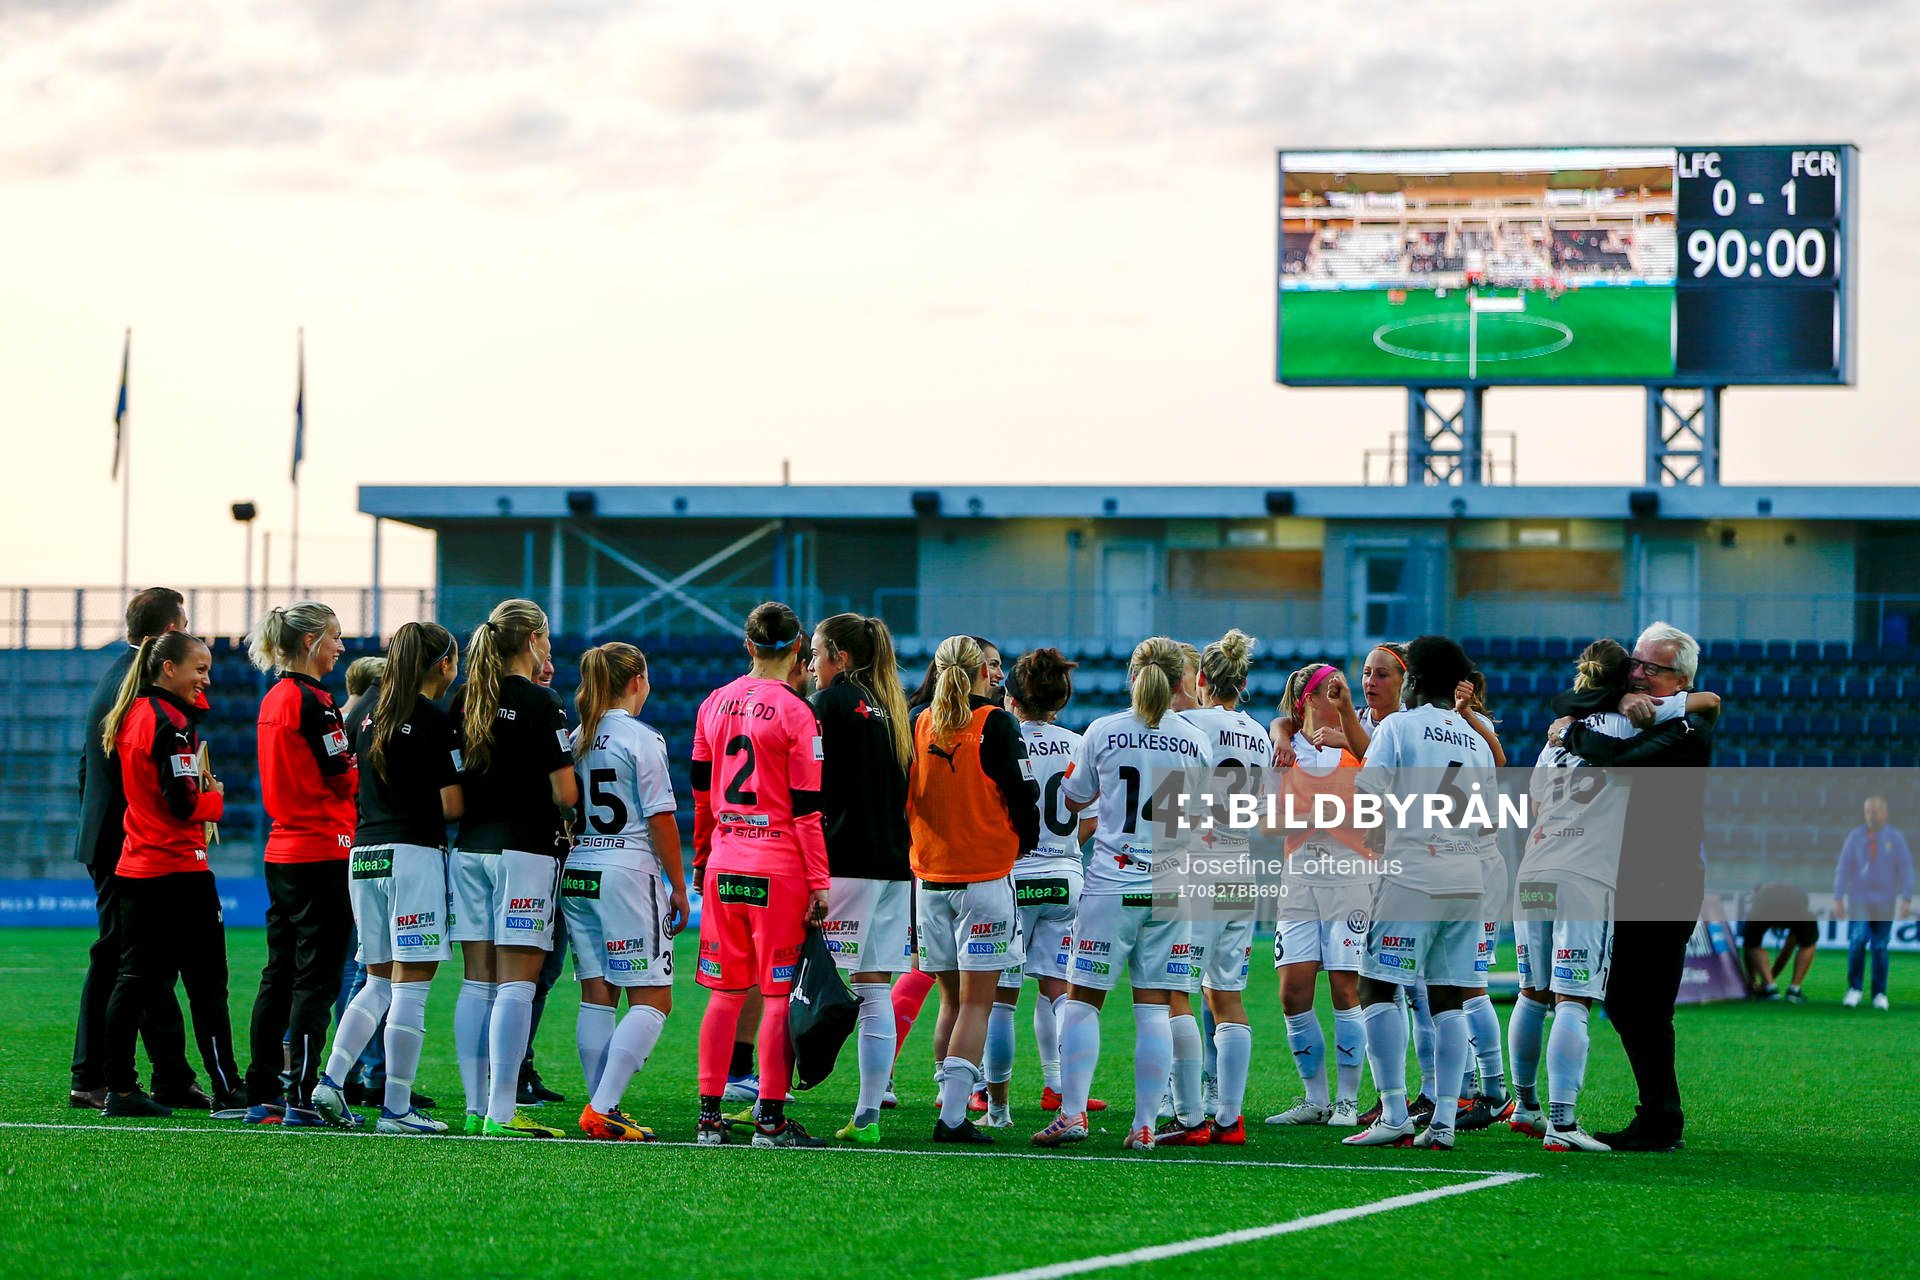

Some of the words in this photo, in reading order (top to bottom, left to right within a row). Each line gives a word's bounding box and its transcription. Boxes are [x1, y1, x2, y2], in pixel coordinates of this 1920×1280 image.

[1678, 152, 1721, 178] LFC
[1791, 151, 1836, 177] FCR
[1712, 179, 1736, 216] 0
[1781, 178, 1796, 216] 1
[1687, 228, 1826, 278] 90:00
[1108, 733, 1199, 758] FOLKESSON
[1219, 730, 1265, 754] MITTAG
[1424, 727, 1477, 751] ASANTE
[1029, 741, 1071, 756] ASAR
[724, 735, 758, 806] 2
[1037, 771, 1079, 837] 0
[1119, 766, 1186, 839] 14
[338, 834, 351, 848] KB
[352, 859, 378, 872] akea
[561, 876, 586, 890] akea
[720, 882, 751, 897] akea
[1017, 886, 1052, 899] akea
[1520, 889, 1543, 902] akea
[399, 936, 420, 944] MKB
[971, 944, 992, 952] MKB
[611, 961, 628, 970] MKB
[1077, 959, 1092, 969] MKB
[1381, 955, 1398, 965] MKB
[776, 967, 792, 977] MK
